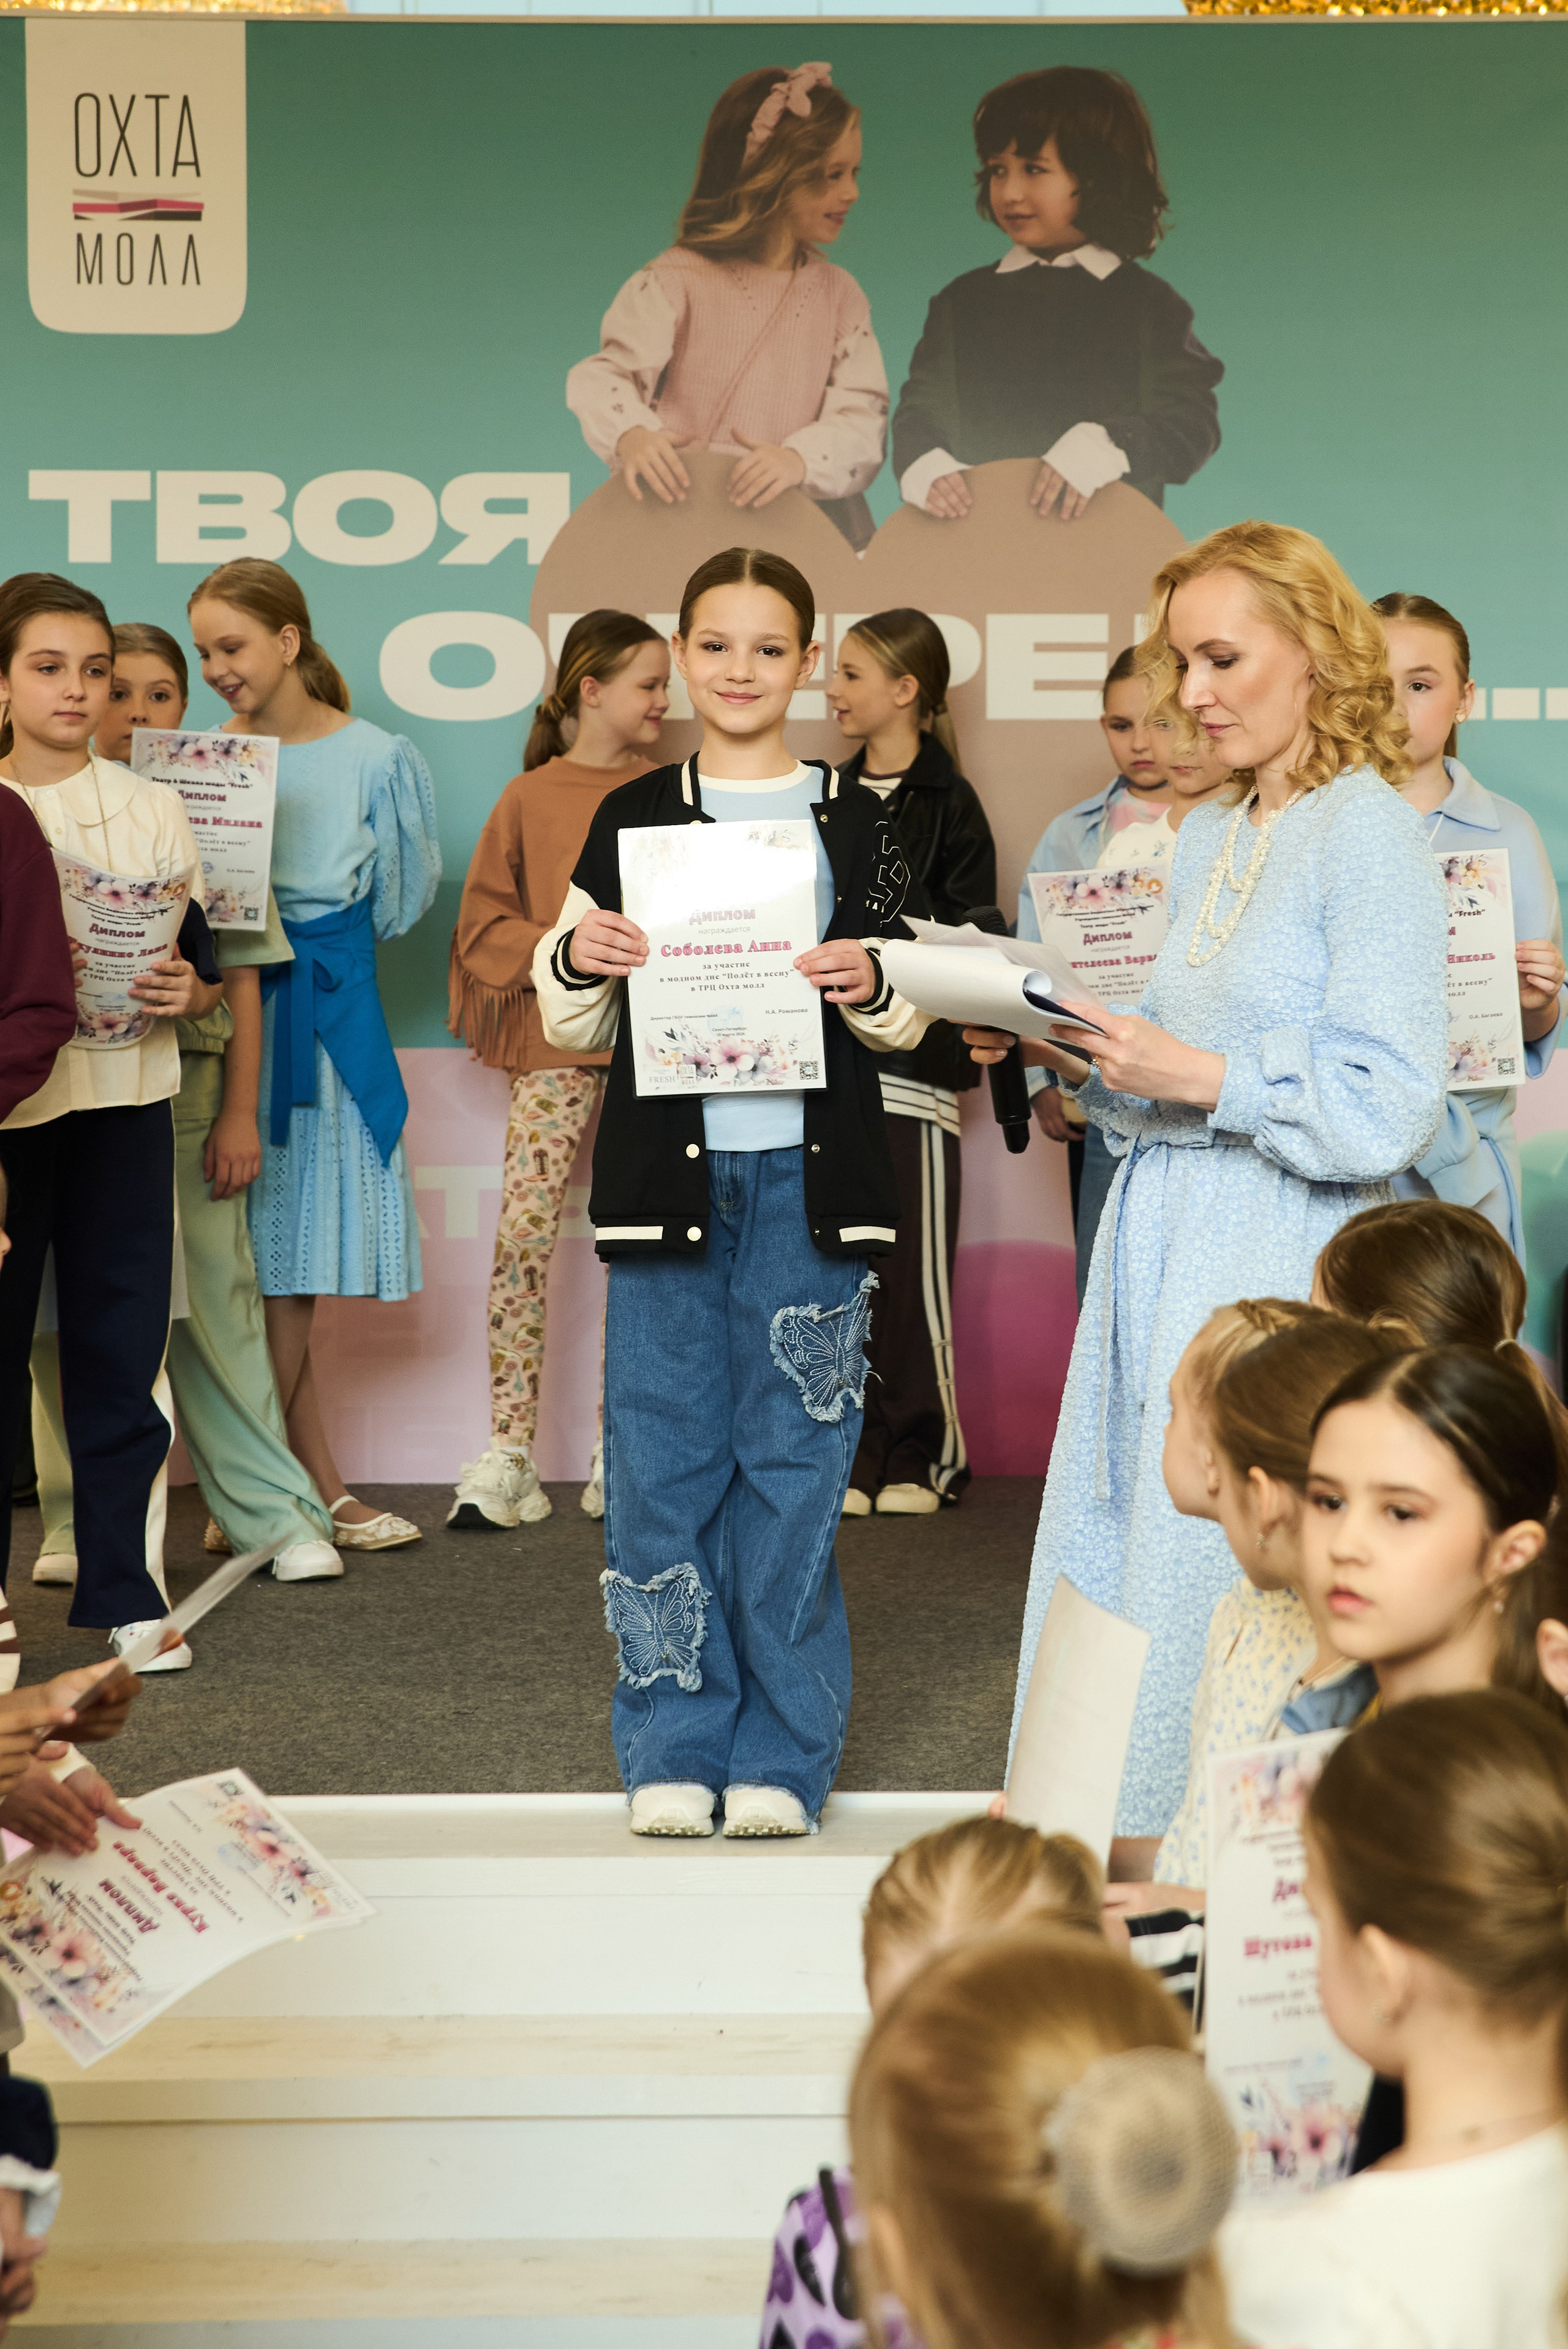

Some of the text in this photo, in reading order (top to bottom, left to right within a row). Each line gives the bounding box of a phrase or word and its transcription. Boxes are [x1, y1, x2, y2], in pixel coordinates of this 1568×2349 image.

[74, 92, 202, 178] ОХТА
[76, 232, 202, 286] МОЛЛ
[29, 469, 570, 566] ТВОЯ
[212, 816, 263, 828] Милана
[689, 909, 756, 926] Диплом
[89, 923, 145, 938] Диплом
[698, 926, 751, 935] награждается
[1083, 930, 1133, 946] Диплом
[661, 940, 792, 957] Соболева Анна
[714, 962, 750, 971] участие
[1124, 954, 1158, 965] Варв
[113, 1840, 166, 1893] Варвара
[98, 1877, 160, 1934] Диплом
